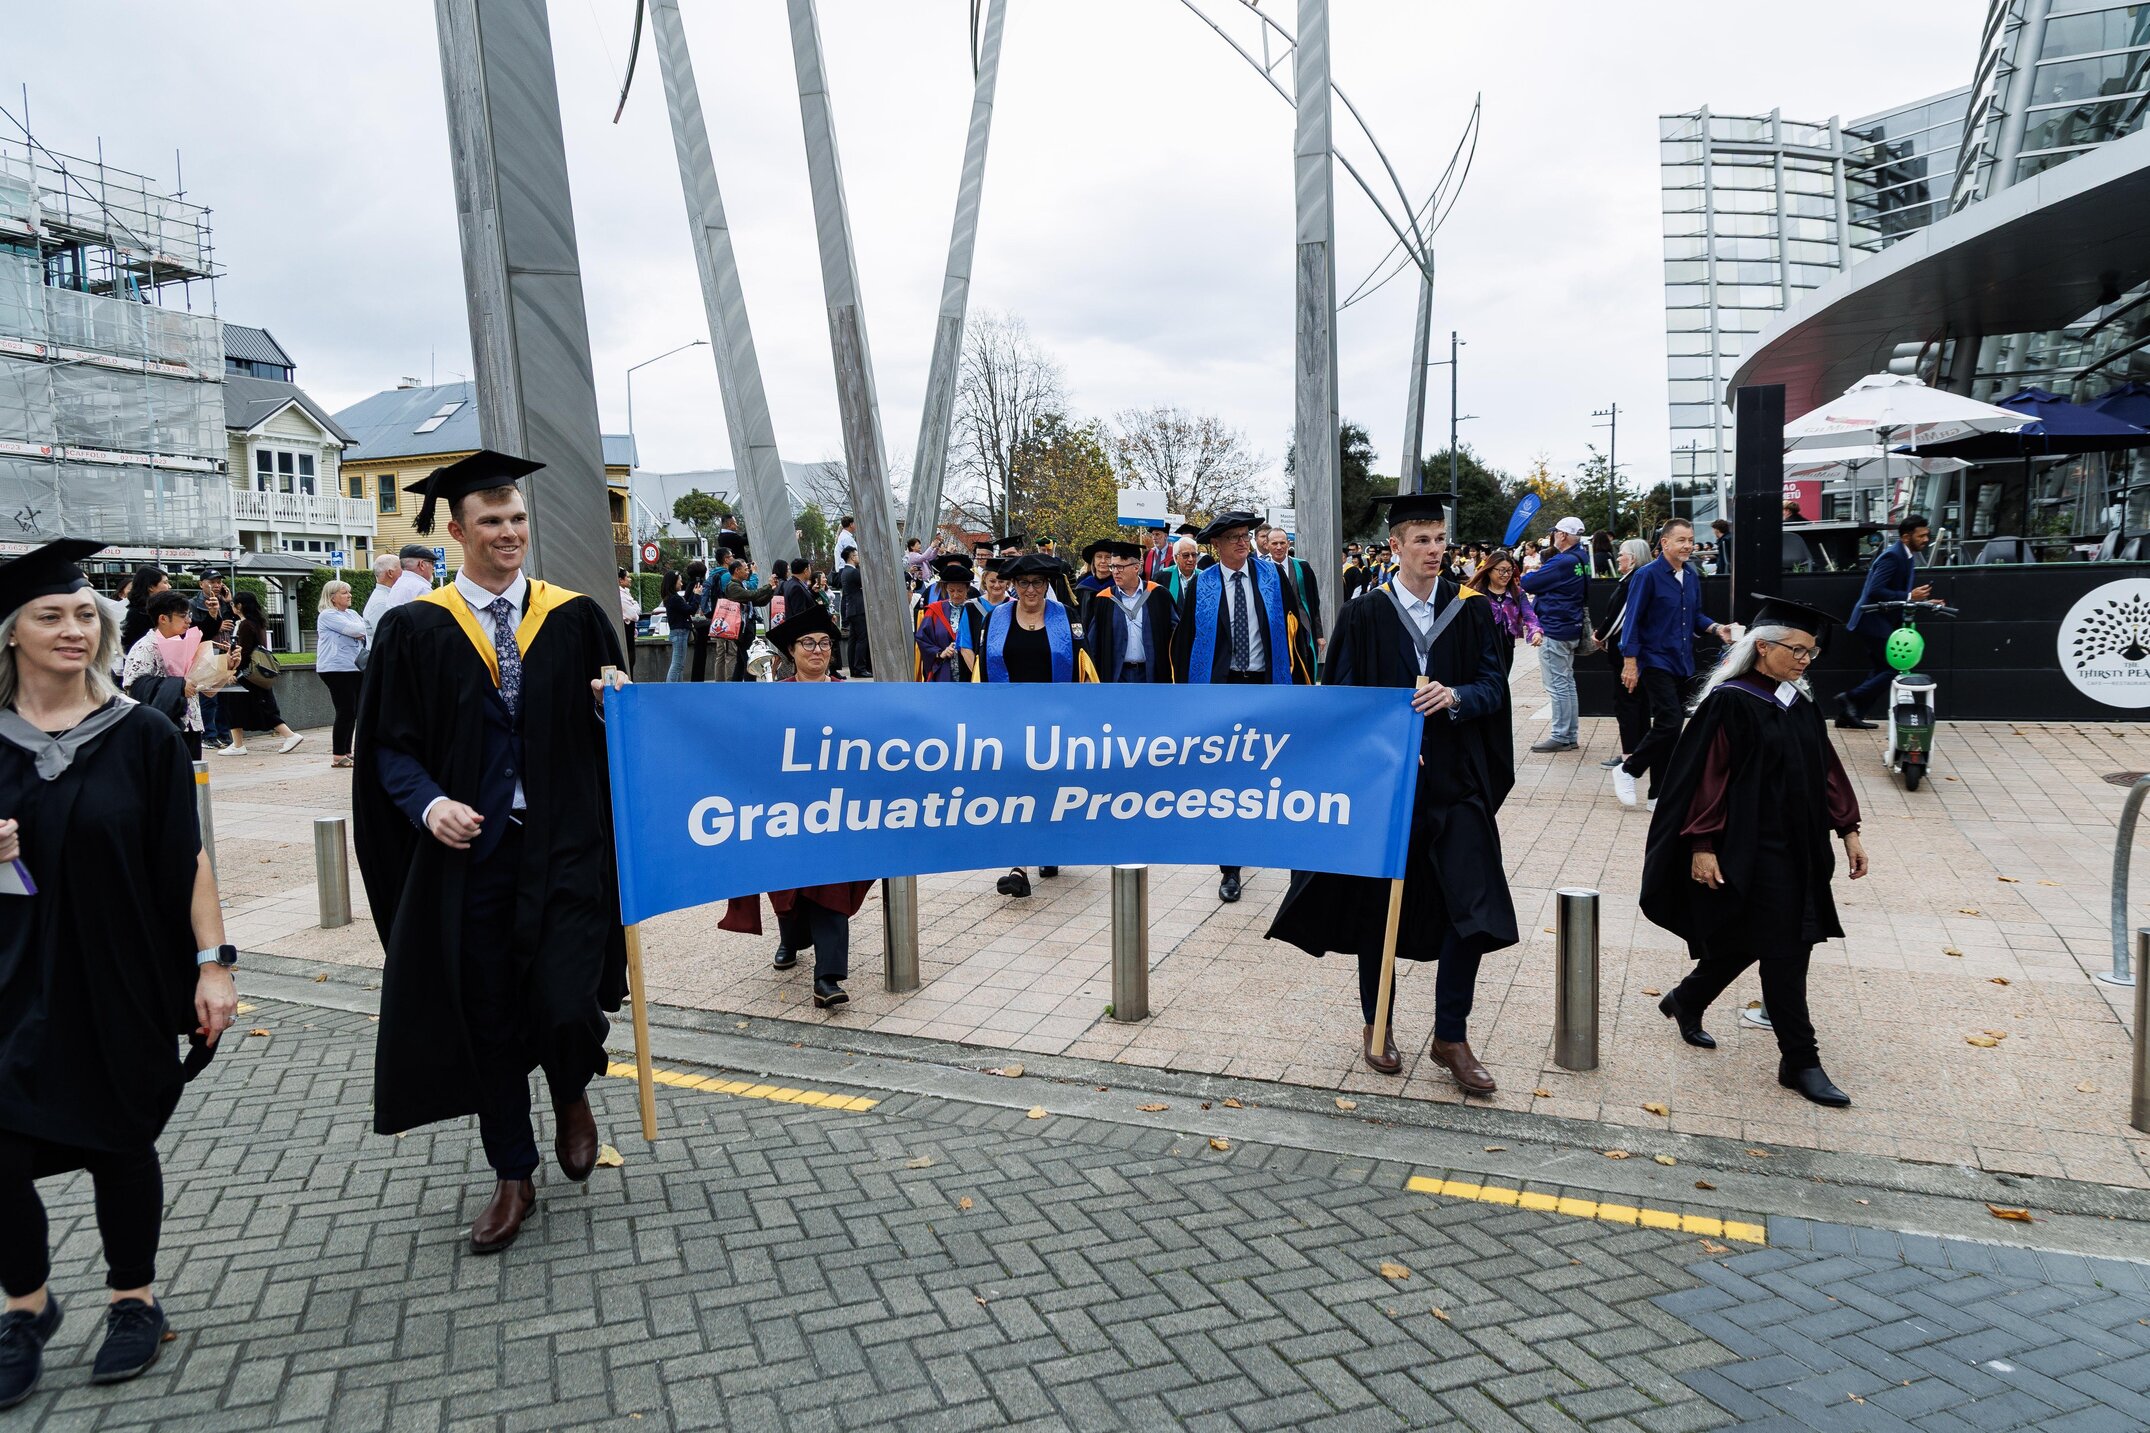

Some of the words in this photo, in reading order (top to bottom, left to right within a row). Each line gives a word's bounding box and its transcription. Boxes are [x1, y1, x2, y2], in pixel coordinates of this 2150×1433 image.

[646, 549, 656, 558] 30
[2079, 669, 2123, 679] THIRSTY
[781, 723, 1003, 772] Lincoln
[1025, 722, 1291, 771] University
[687, 786, 1036, 847] Graduation
[1050, 777, 1350, 825] Procession
